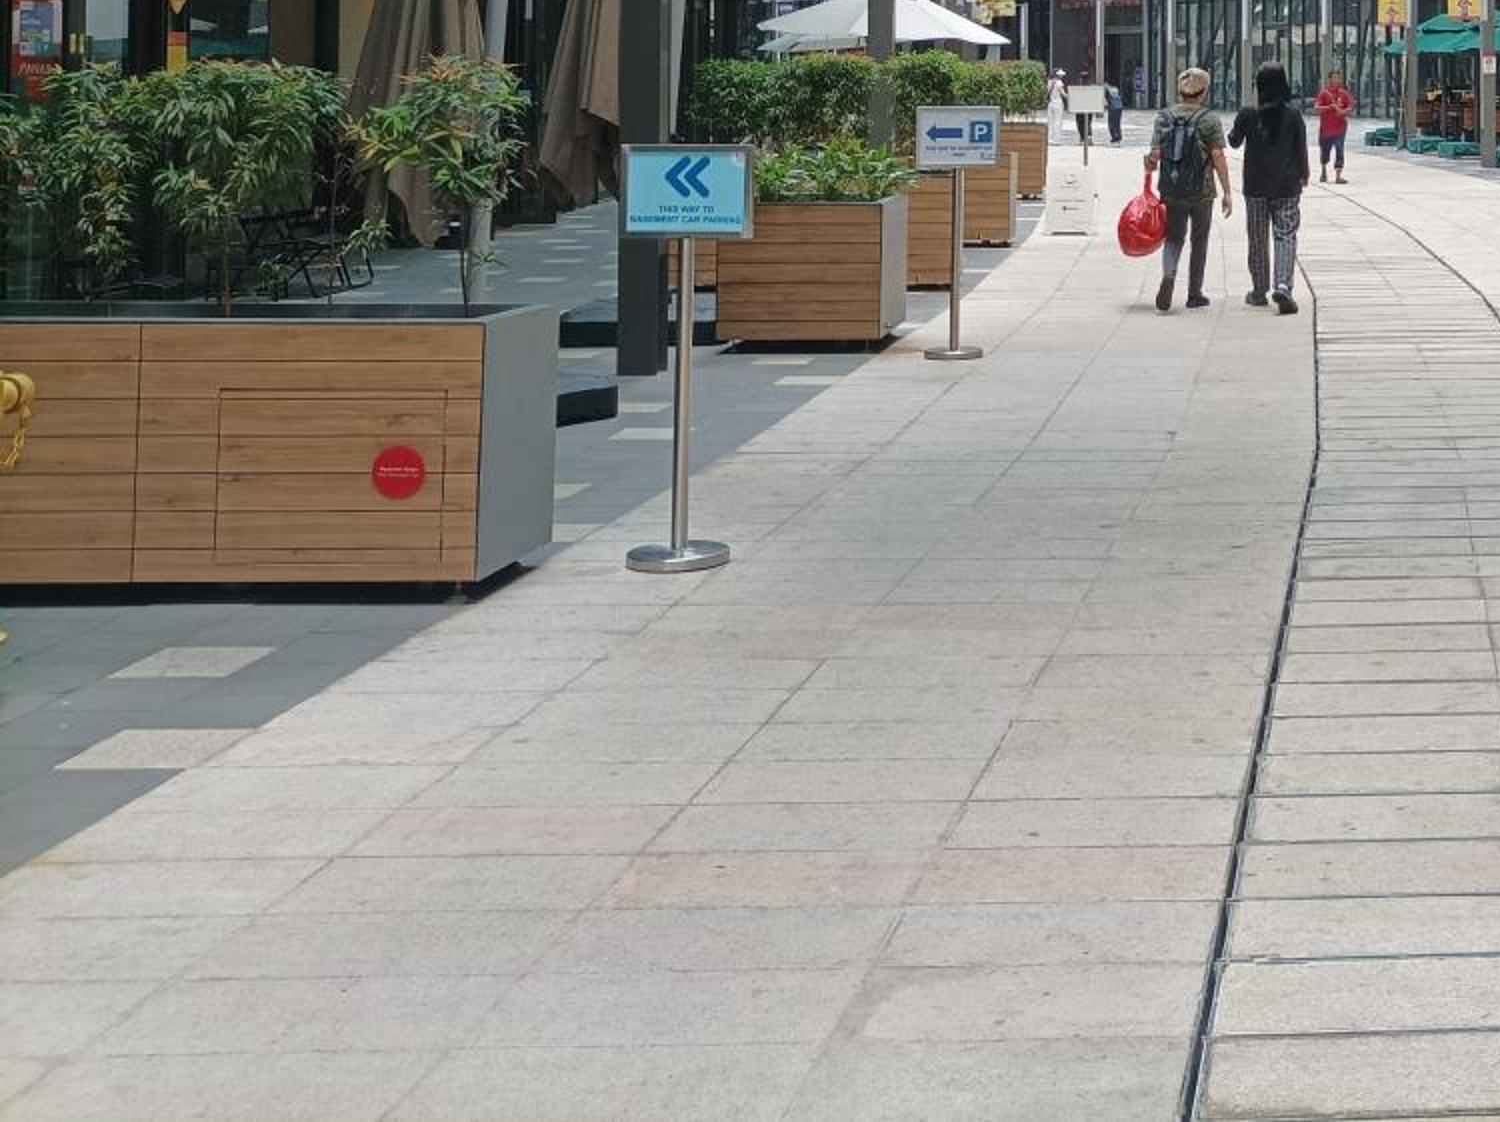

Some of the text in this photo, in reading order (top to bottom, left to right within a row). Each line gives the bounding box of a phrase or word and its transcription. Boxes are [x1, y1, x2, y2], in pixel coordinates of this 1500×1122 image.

[973, 124, 988, 140] P
[681, 205, 701, 213] WAY
[703, 205, 715, 213] TO
